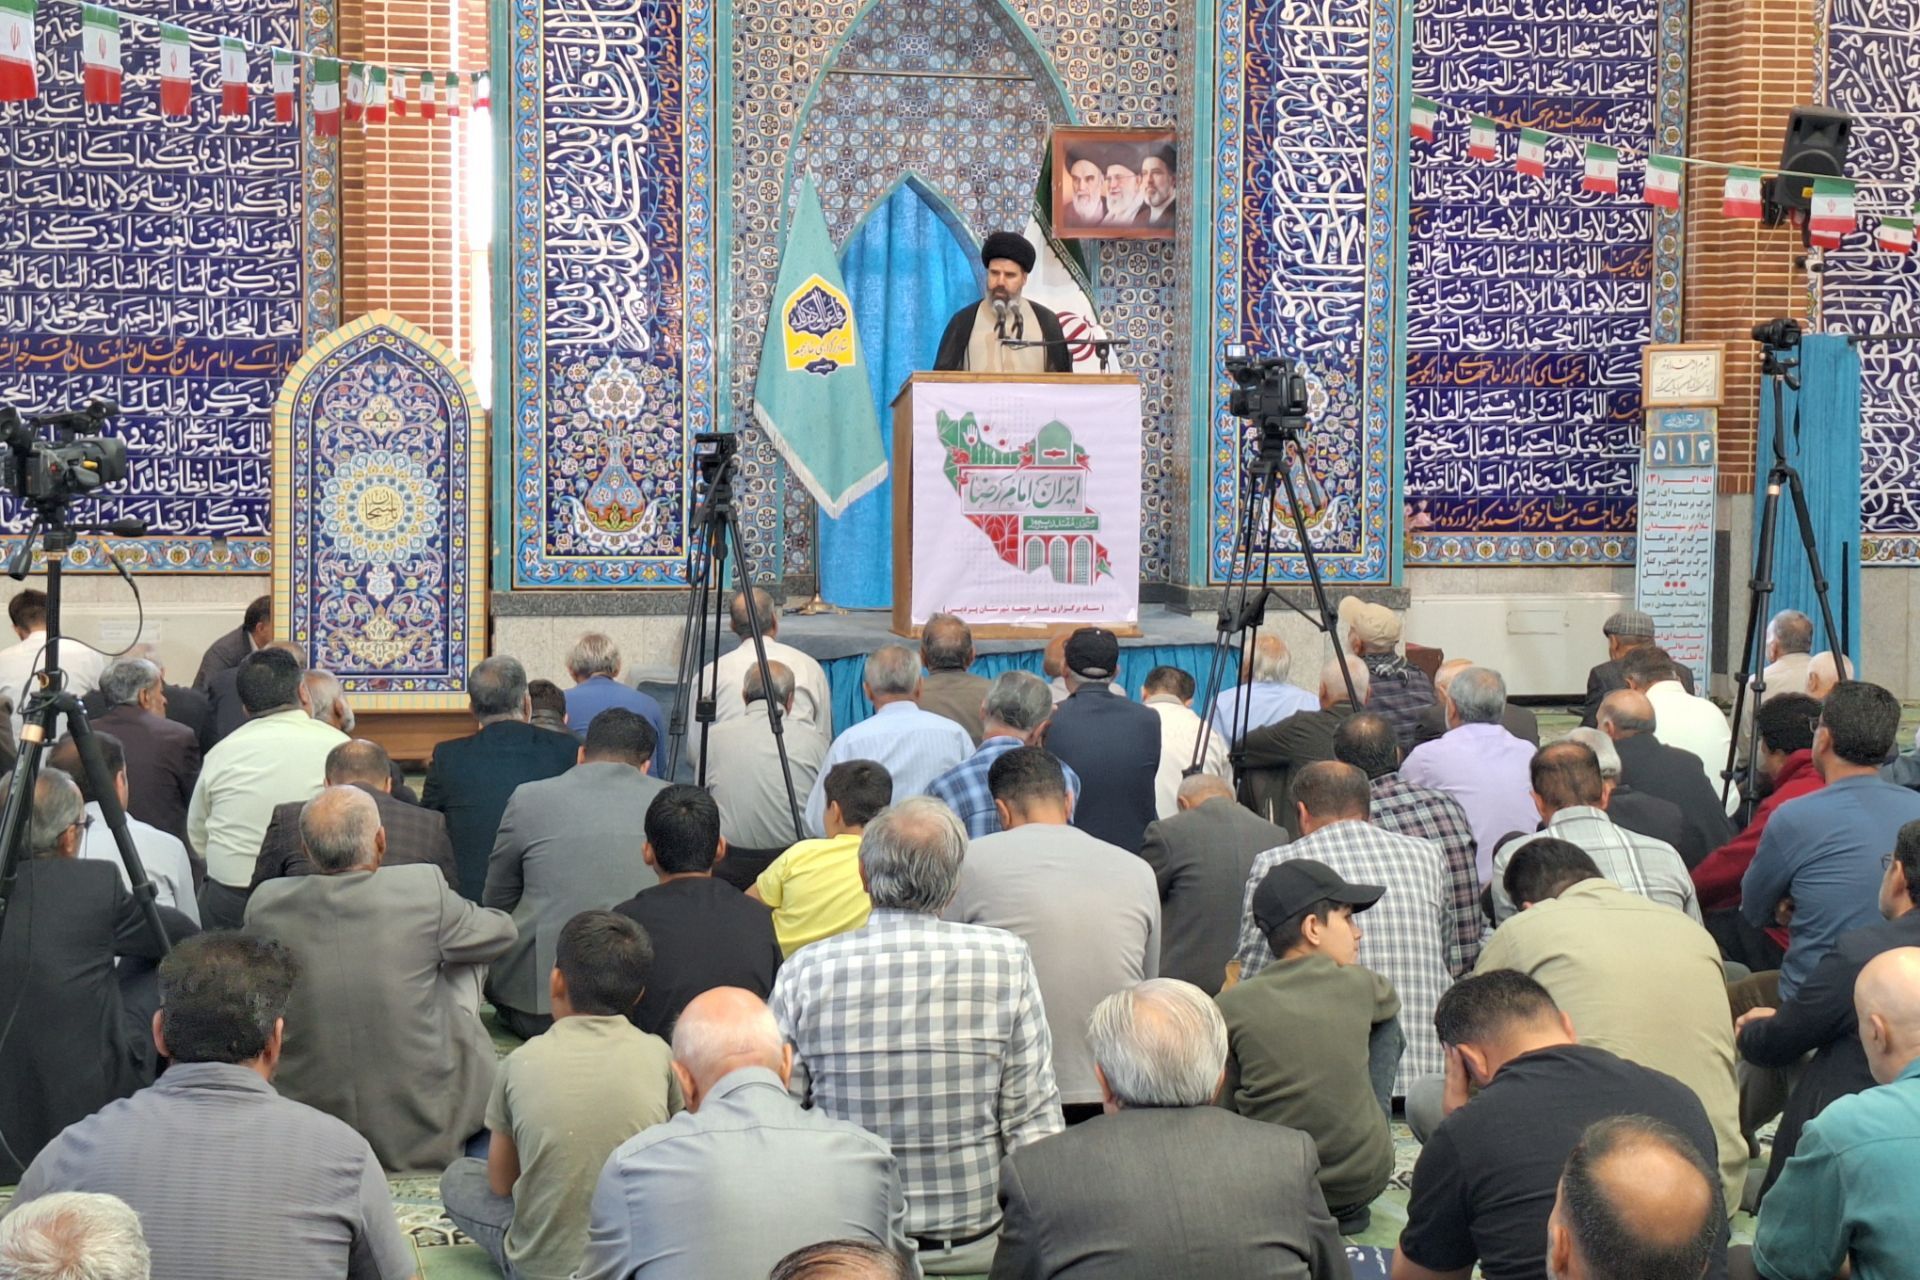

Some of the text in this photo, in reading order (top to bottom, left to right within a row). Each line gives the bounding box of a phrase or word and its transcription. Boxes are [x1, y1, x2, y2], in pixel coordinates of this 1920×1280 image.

[969, 475, 1081, 508] ایران امام رضا
